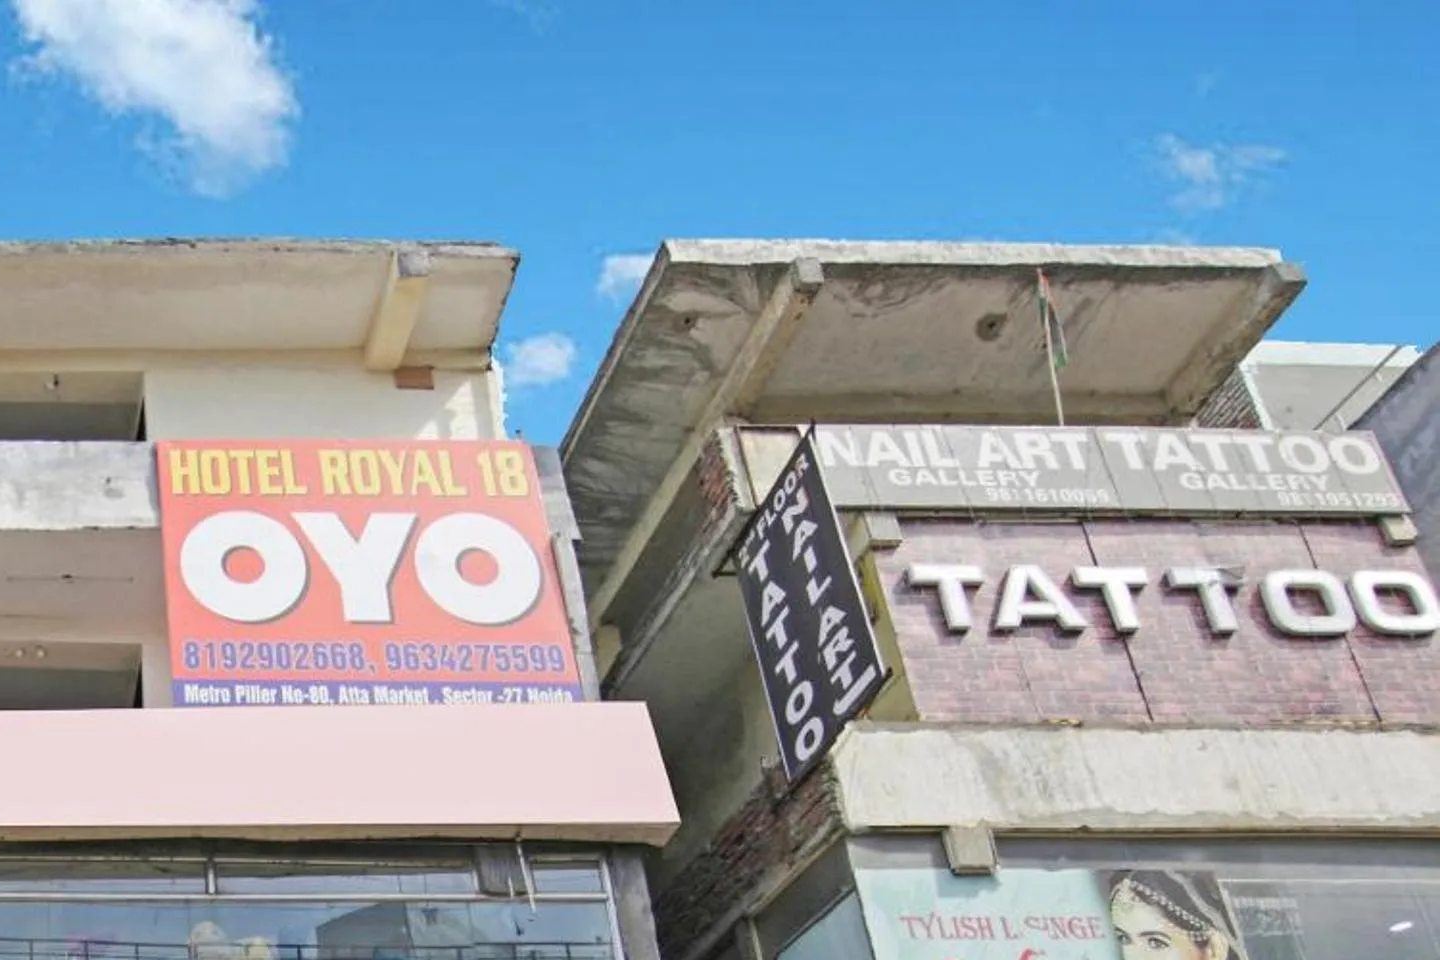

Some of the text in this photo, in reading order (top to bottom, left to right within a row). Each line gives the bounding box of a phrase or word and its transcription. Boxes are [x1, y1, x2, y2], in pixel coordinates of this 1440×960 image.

[170, 448, 529, 497] HOTEL ROYAL 18
[816, 428, 1381, 474] NAIL ART TATTOO
[756, 453, 810, 540] FLOOR
[888, 468, 1041, 487] GALLERY
[1179, 472, 1329, 491] GALLERY
[179, 510, 544, 626] OYO
[907, 562, 1440, 637] TATTOO
[183, 640, 566, 674] 8192902668, 9634275599
[749, 540, 825, 762] TATTOO
[184, 683, 232, 704] Metro
[338, 684, 372, 705] Atta
[374, 684, 430, 706] Market
